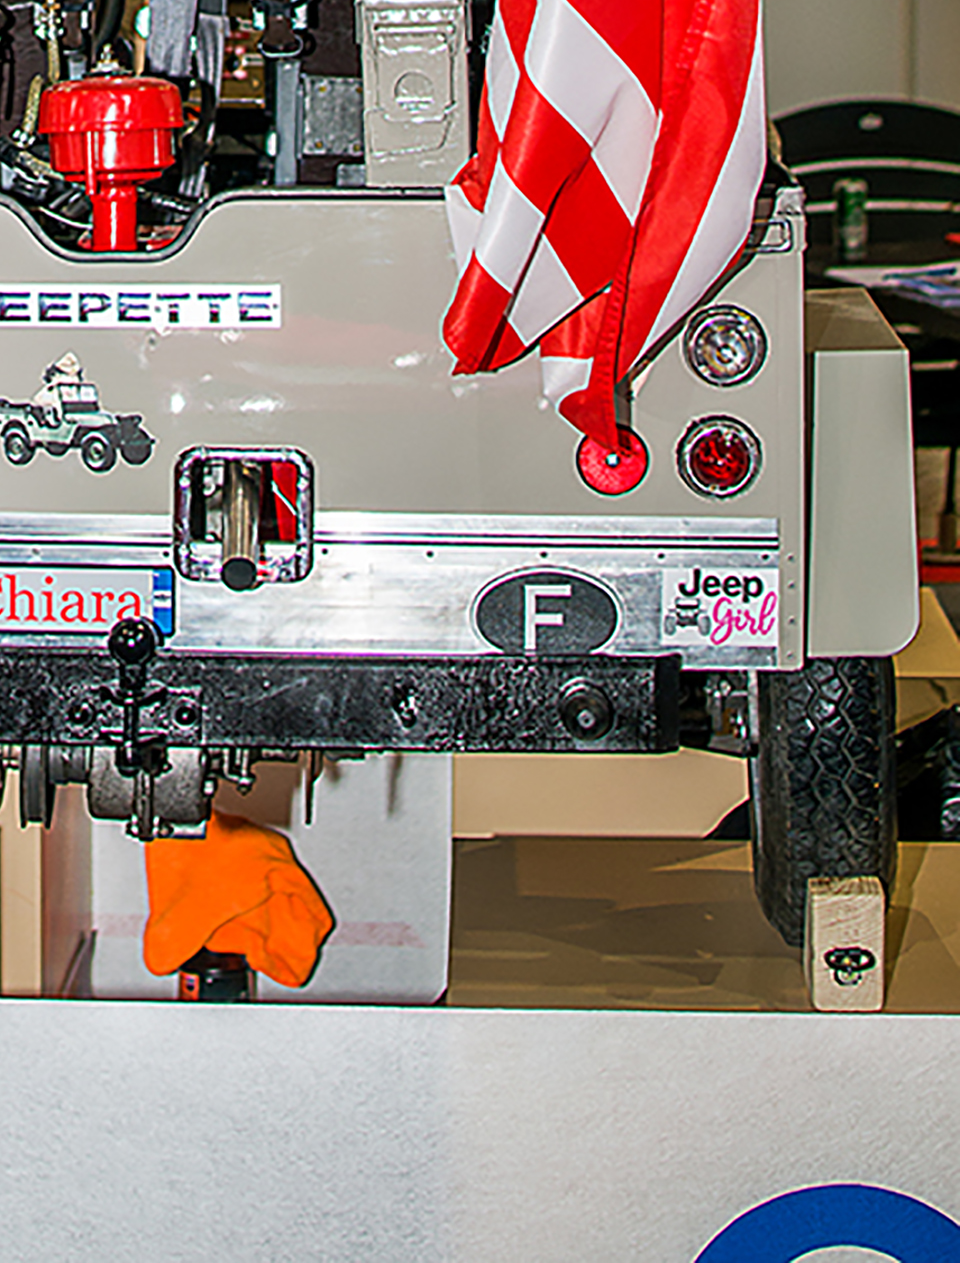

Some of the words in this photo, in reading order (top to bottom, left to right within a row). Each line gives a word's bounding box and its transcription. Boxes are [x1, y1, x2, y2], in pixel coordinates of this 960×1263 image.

[678, 568, 764, 604] Jeep
[524, 585, 572, 653] F
[710, 591, 778, 646] Girl
